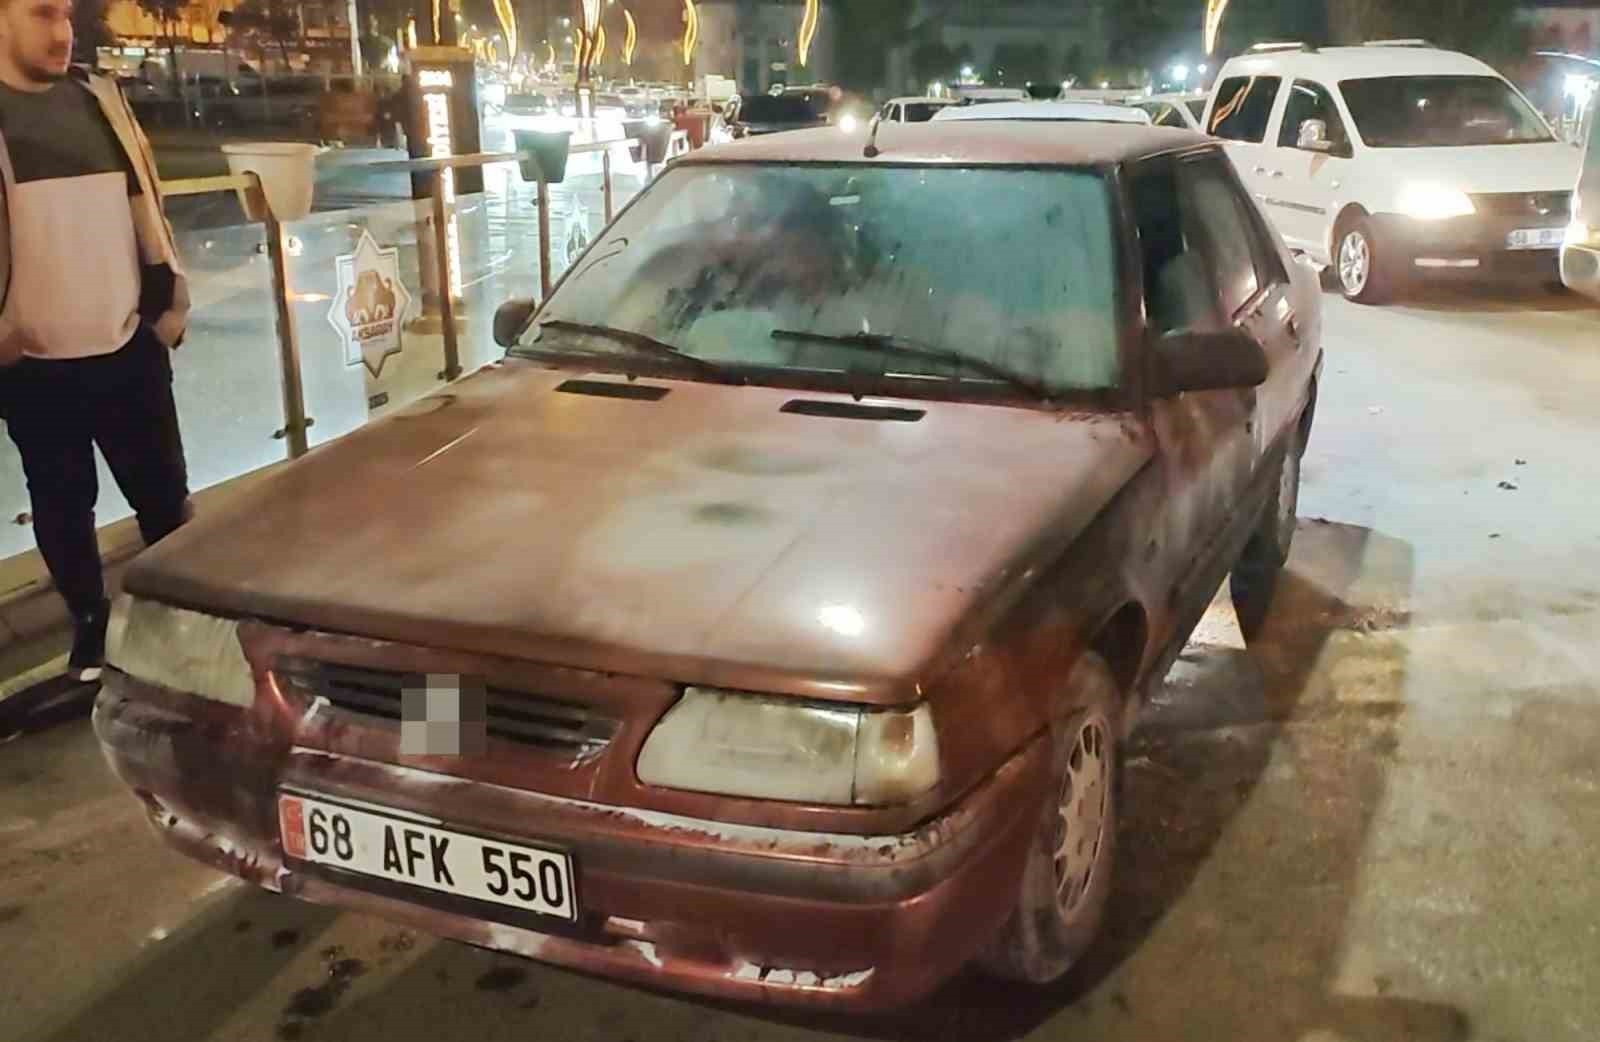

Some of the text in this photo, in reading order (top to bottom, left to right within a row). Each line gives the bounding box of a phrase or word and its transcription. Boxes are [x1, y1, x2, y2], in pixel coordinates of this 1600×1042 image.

[309, 808, 564, 908] 68 AFK 550
